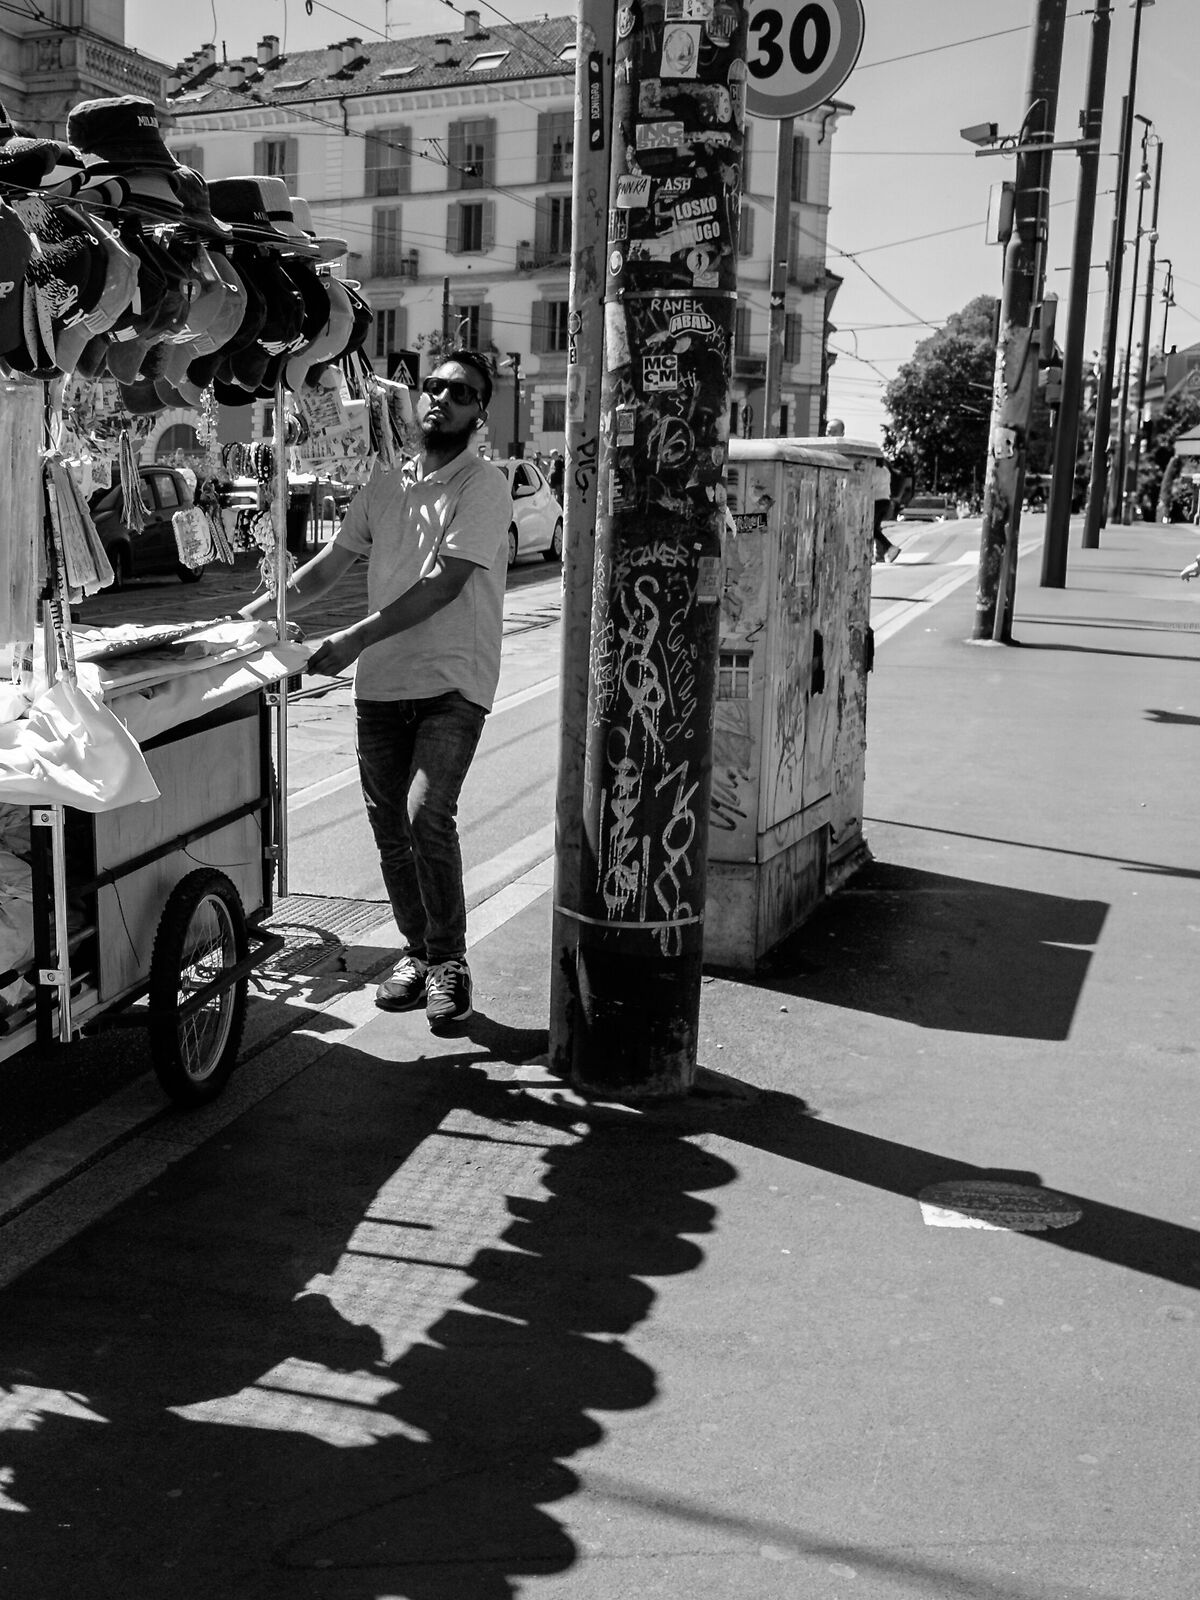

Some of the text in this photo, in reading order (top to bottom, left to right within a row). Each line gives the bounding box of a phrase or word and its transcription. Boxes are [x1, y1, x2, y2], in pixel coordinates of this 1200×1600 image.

[748, 3, 832, 79] 30
[675, 196, 717, 220] LOSKO
[644, 356, 677, 371] MC
